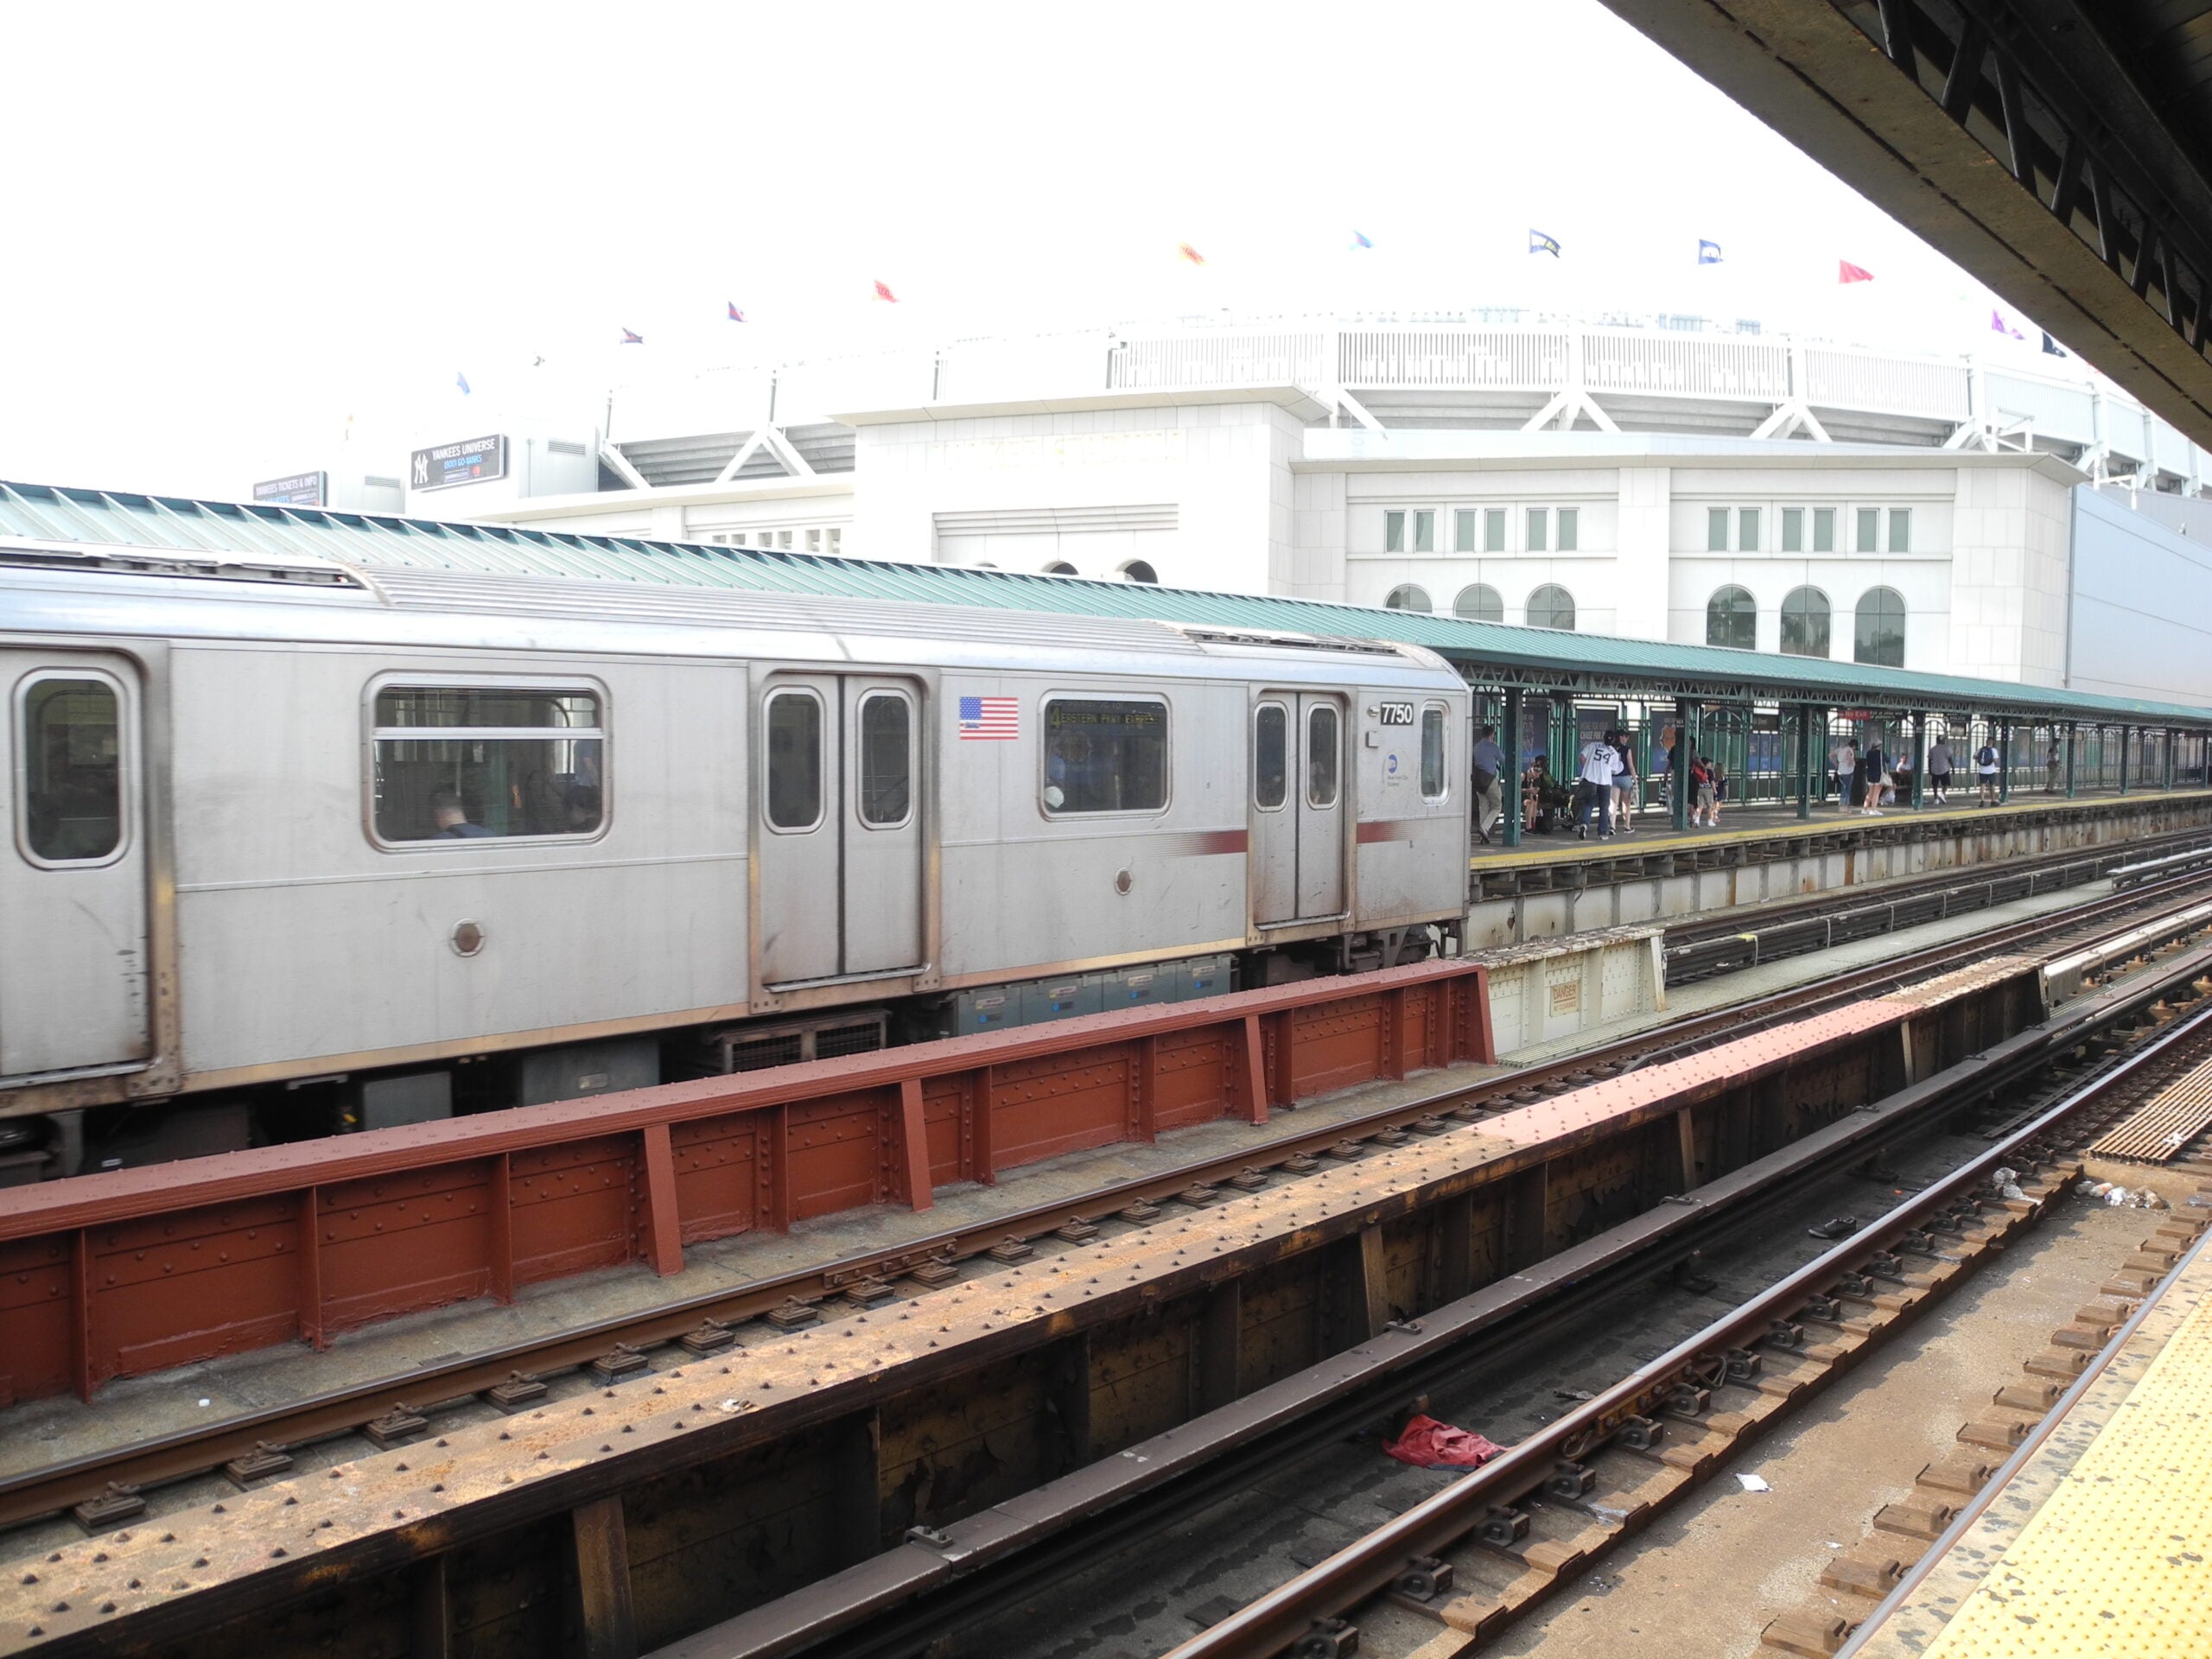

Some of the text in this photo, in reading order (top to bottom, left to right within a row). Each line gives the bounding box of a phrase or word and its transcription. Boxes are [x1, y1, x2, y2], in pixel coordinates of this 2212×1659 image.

[432, 438, 496, 461] YANKEES UNIVERSE
[278, 479, 299, 492] TICKETS
[304, 475, 317, 486] INFO
[1051, 707, 1061, 728] 4
[1382, 703, 1413, 723] 7750
[1593, 748, 1611, 765] 54
[1553, 984, 1577, 1001] DANGER
